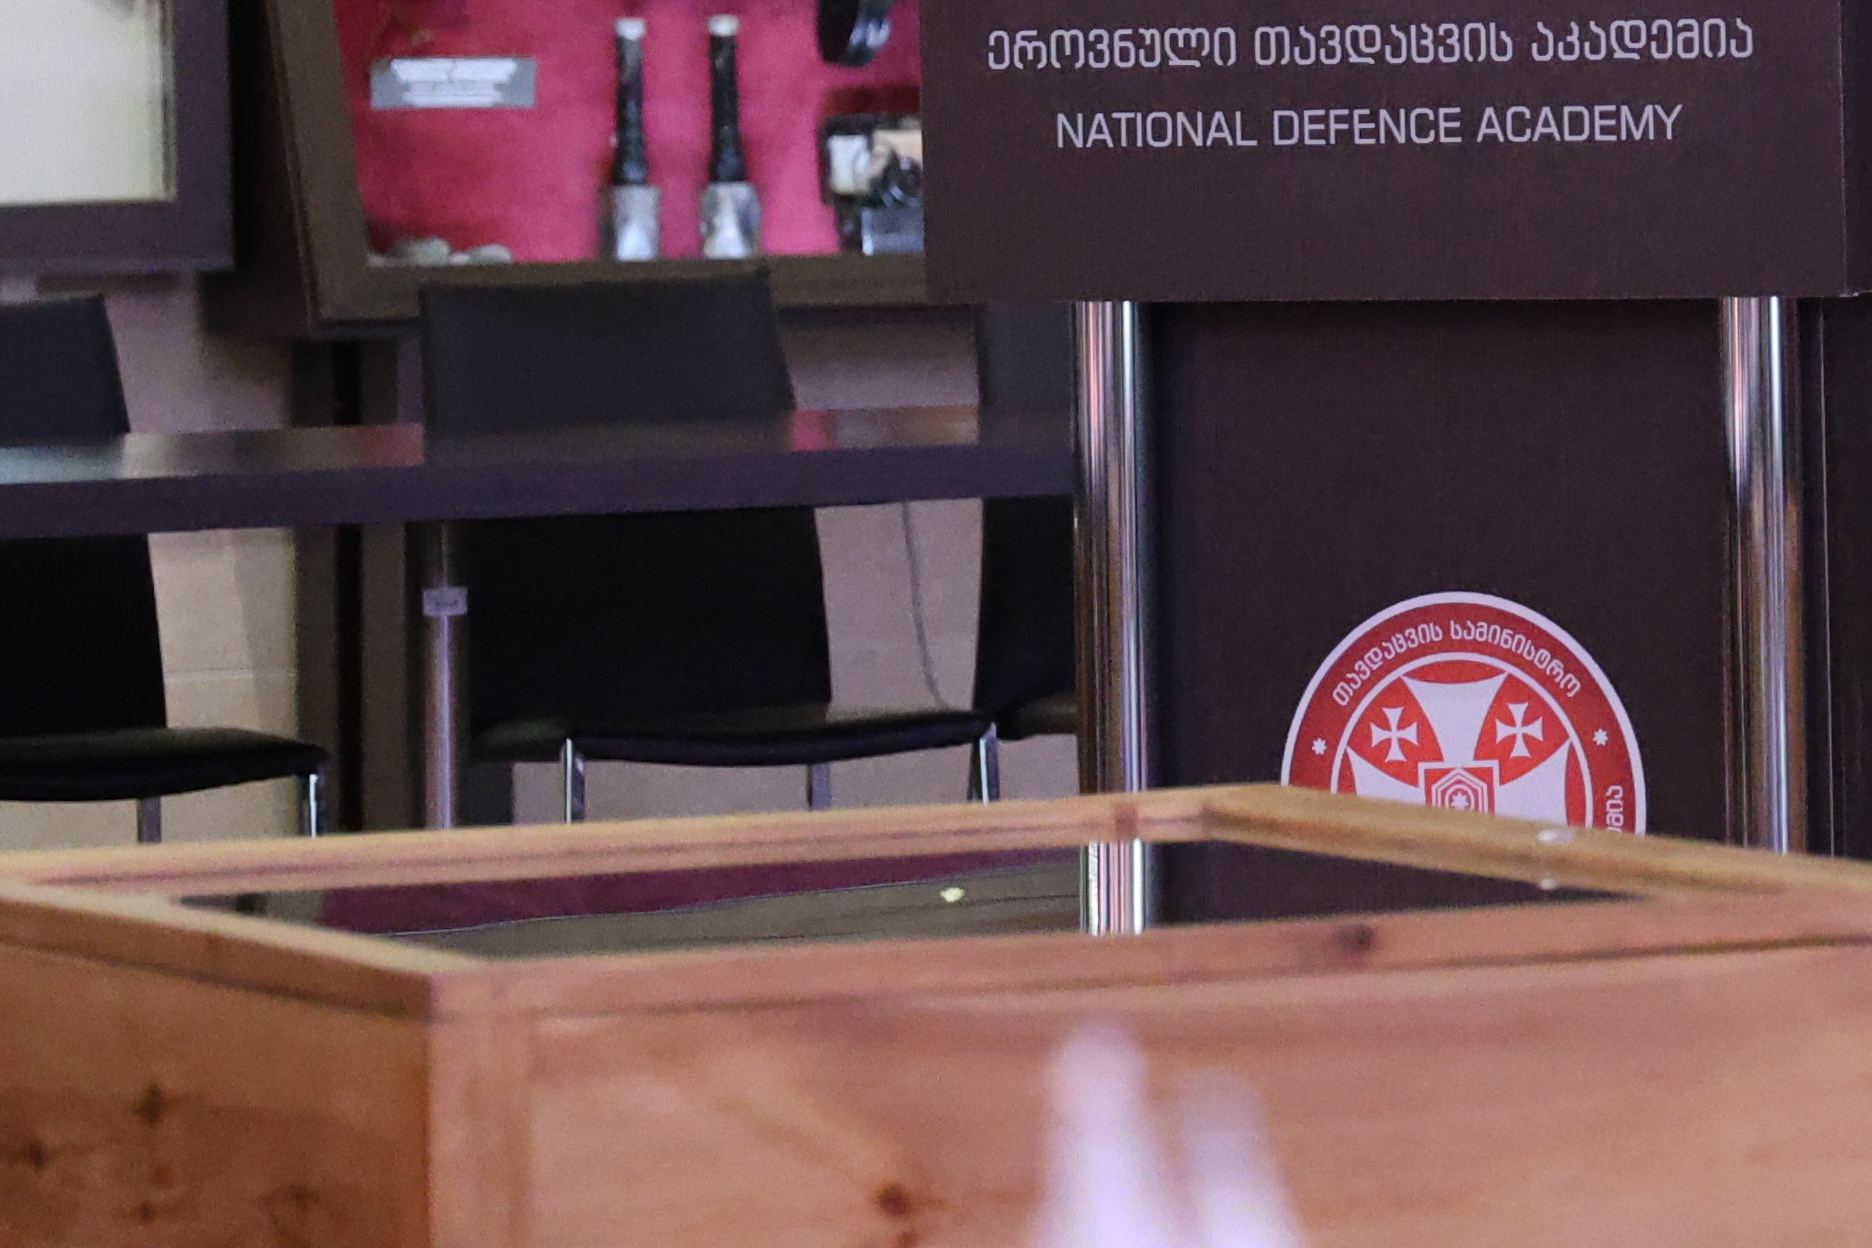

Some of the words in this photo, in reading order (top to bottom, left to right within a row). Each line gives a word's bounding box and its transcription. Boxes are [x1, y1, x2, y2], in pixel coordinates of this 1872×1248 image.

[988, 26, 1237, 71] ეროვნული
[1254, 22, 1513, 66] თავდაცვის
[1531, 17, 1754, 63] აკადემია
[1057, 110, 1258, 148] NATIONAL
[1273, 106, 1463, 146] DEFENCE
[1476, 103, 1683, 143] ACADEMY
[1331, 622, 1443, 706] თავდაცვის
[1449, 619, 1582, 699] სამინისტრო
